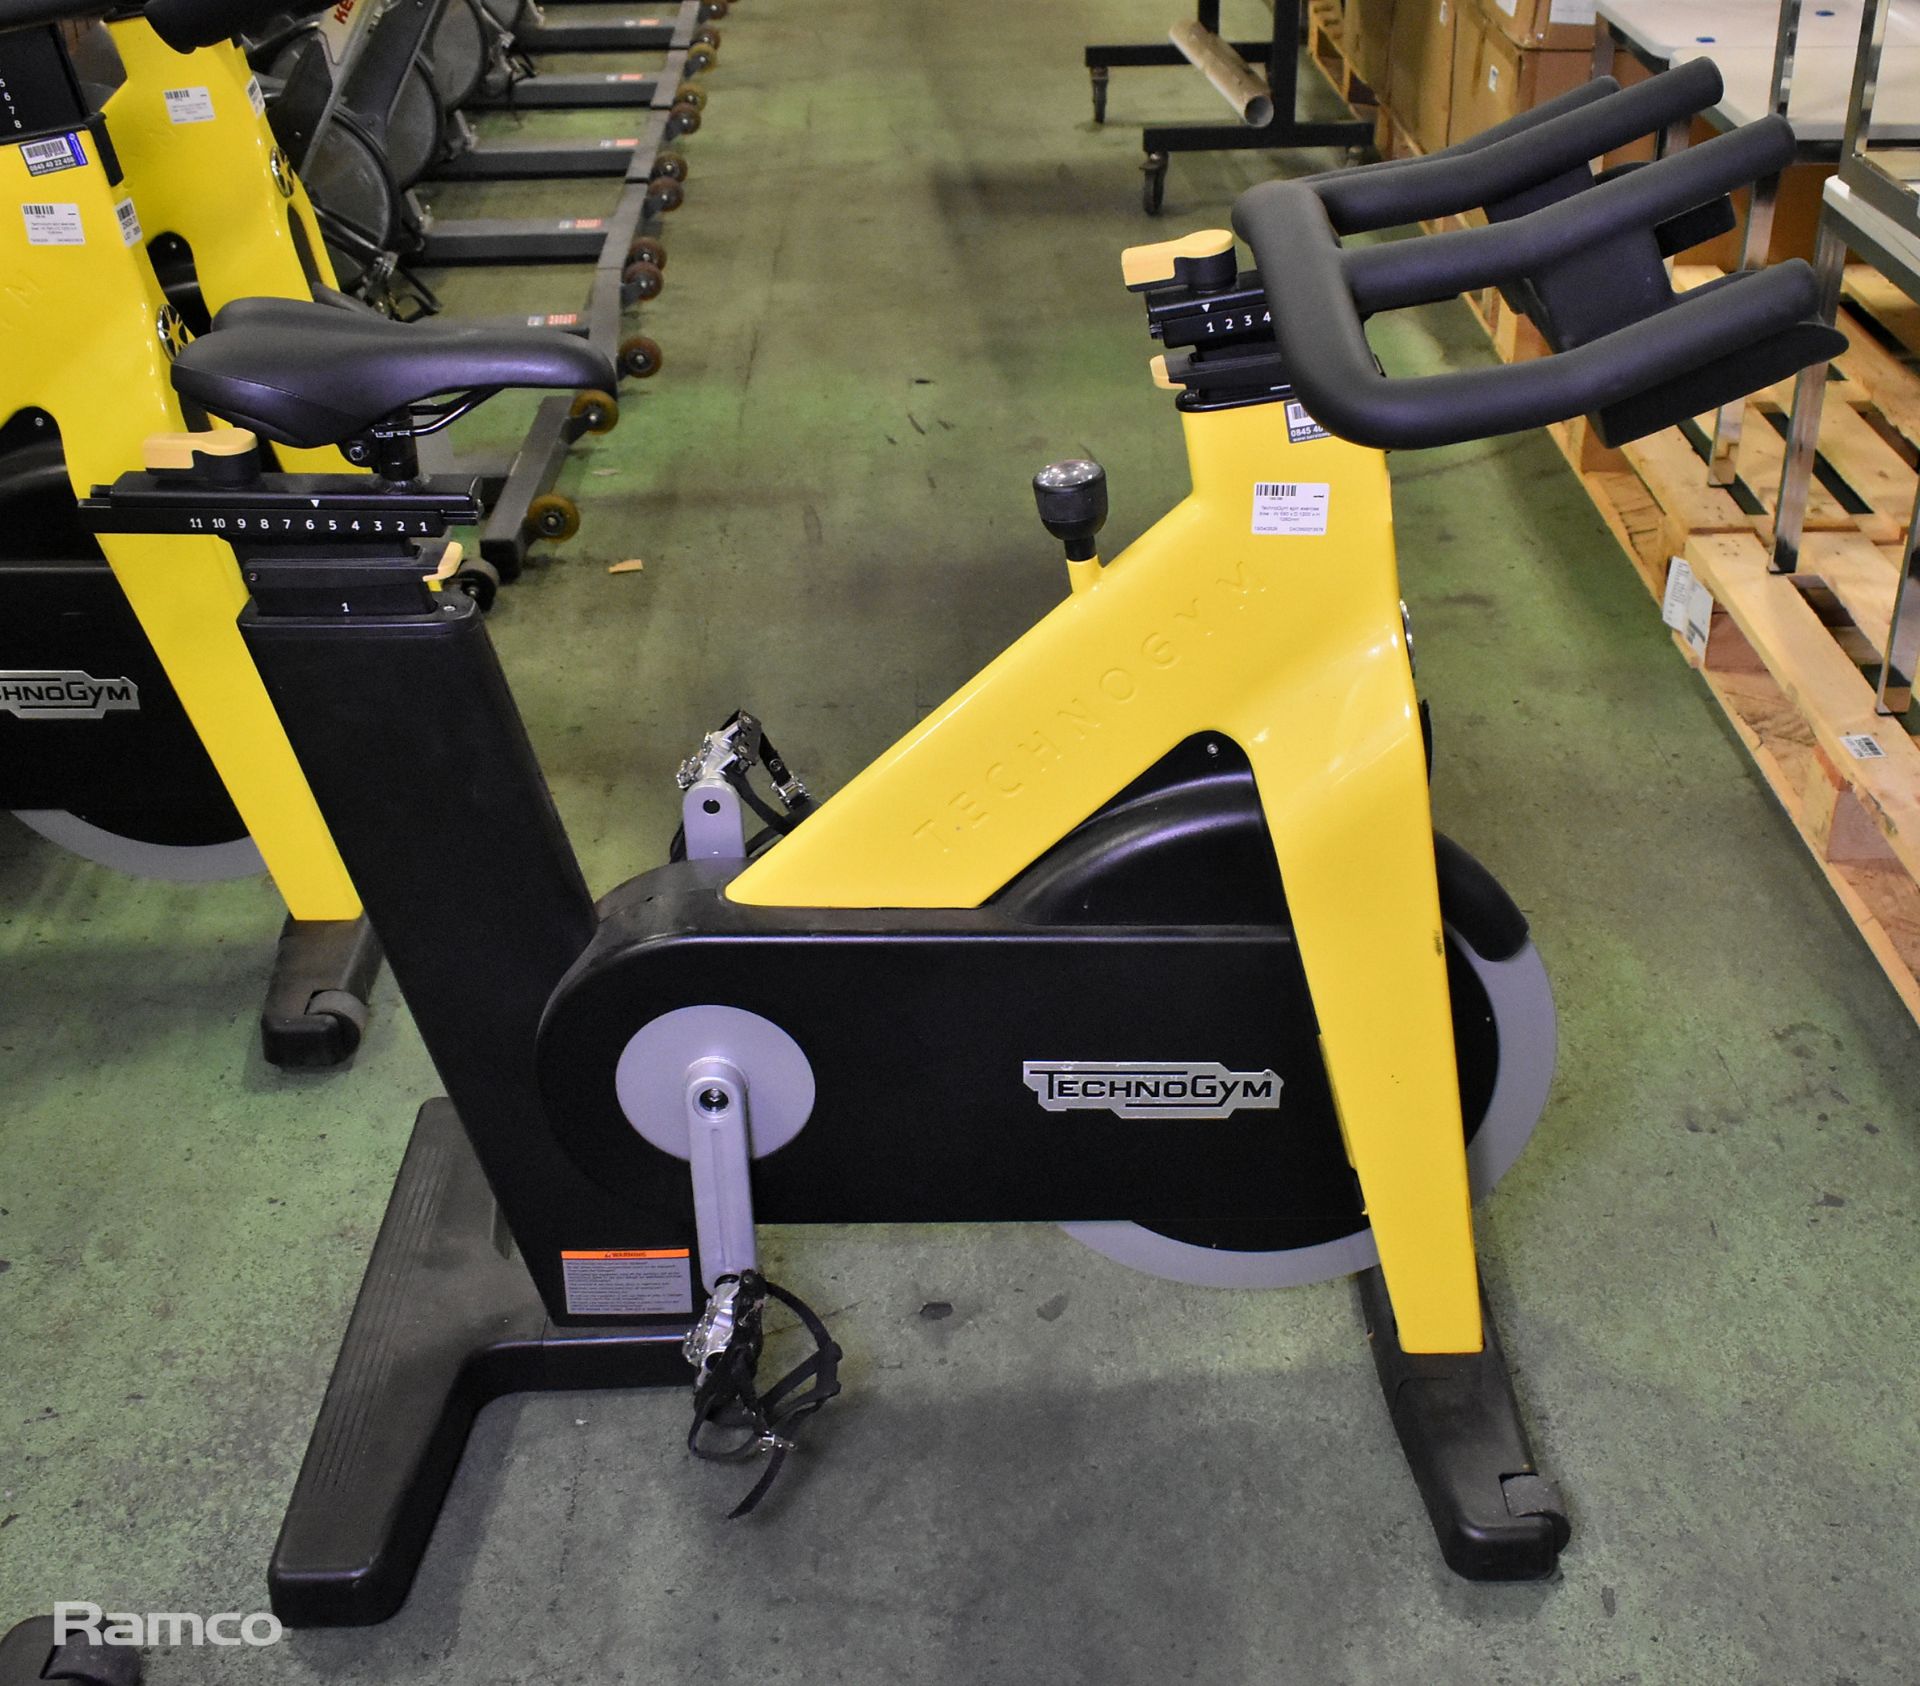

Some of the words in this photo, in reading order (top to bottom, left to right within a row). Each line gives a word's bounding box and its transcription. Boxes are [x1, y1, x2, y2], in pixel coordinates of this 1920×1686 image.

[3, 92, 12, 102] 6
[8, 105, 15, 115] 7
[13, 119, 22, 129] 8
[1206, 321, 1215, 333] 1
[1224, 318, 1234, 330] 2
[1243, 315, 1253, 327] 3
[1262, 311, 1272, 323] 4
[189, 517, 203, 529] 11
[212, 517, 226, 529] 10
[237, 518, 247, 529] 9
[260, 518, 270, 530] 8
[283, 519, 291, 530] 7
[305, 519, 315, 530] 6
[328, 520, 338, 531] 5
[351, 520, 361, 531] 4
[374, 520, 383, 532] 3
[396, 521, 405, 532] 2
[419, 521, 428, 532] 1
[341, 602, 350, 613] 1
[1029, 1070, 1273, 1108] TECHNOGYM
